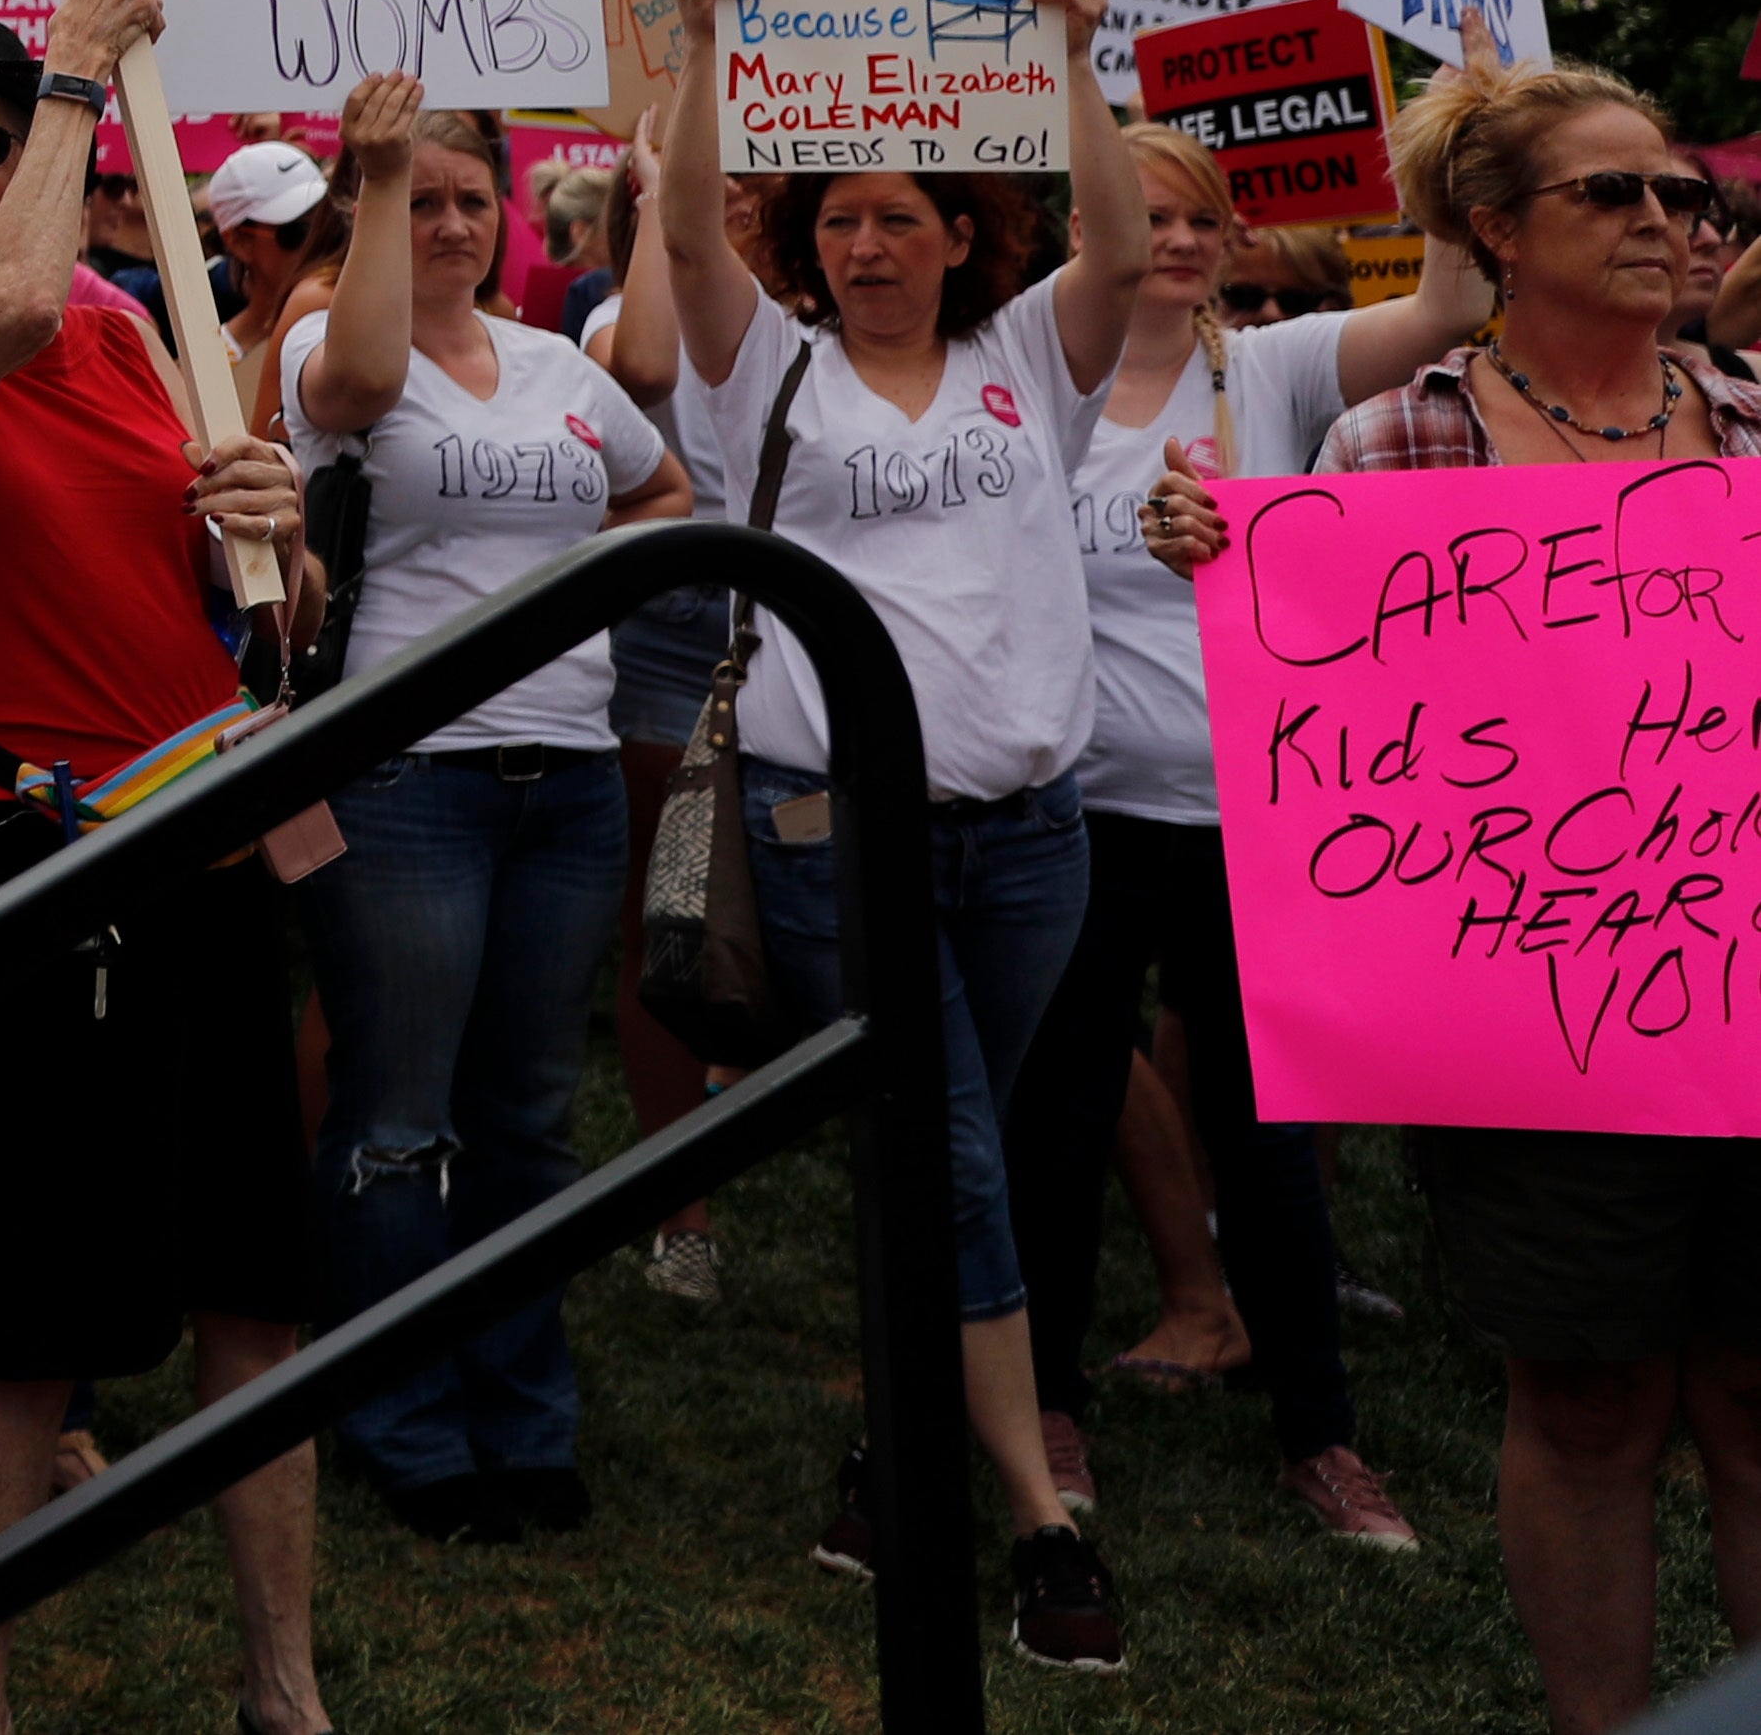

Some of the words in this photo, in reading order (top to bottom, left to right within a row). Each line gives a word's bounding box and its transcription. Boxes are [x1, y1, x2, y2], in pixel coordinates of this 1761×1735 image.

[726, 51, 844, 105] Mary
[866, 52, 1056, 97] Elizabeth
[1160, 27, 1321, 89] PROTECT
[744, 99, 962, 133] COLEMAN
[1230, 86, 1369, 142] LEGAL
[746, 136, 885, 168] NEEDS
[909, 139, 945, 166] TO
[973, 129, 1049, 167] GO!
[1230, 153, 1360, 203] RTION
[433, 433, 604, 505] 1973
[843, 424, 1015, 519] 1973
[1073, 490, 1148, 555] 19
[1246, 488, 1604, 668] CARE
[1310, 806, 1534, 899] OUR
[1451, 870, 1724, 959] HEAR
